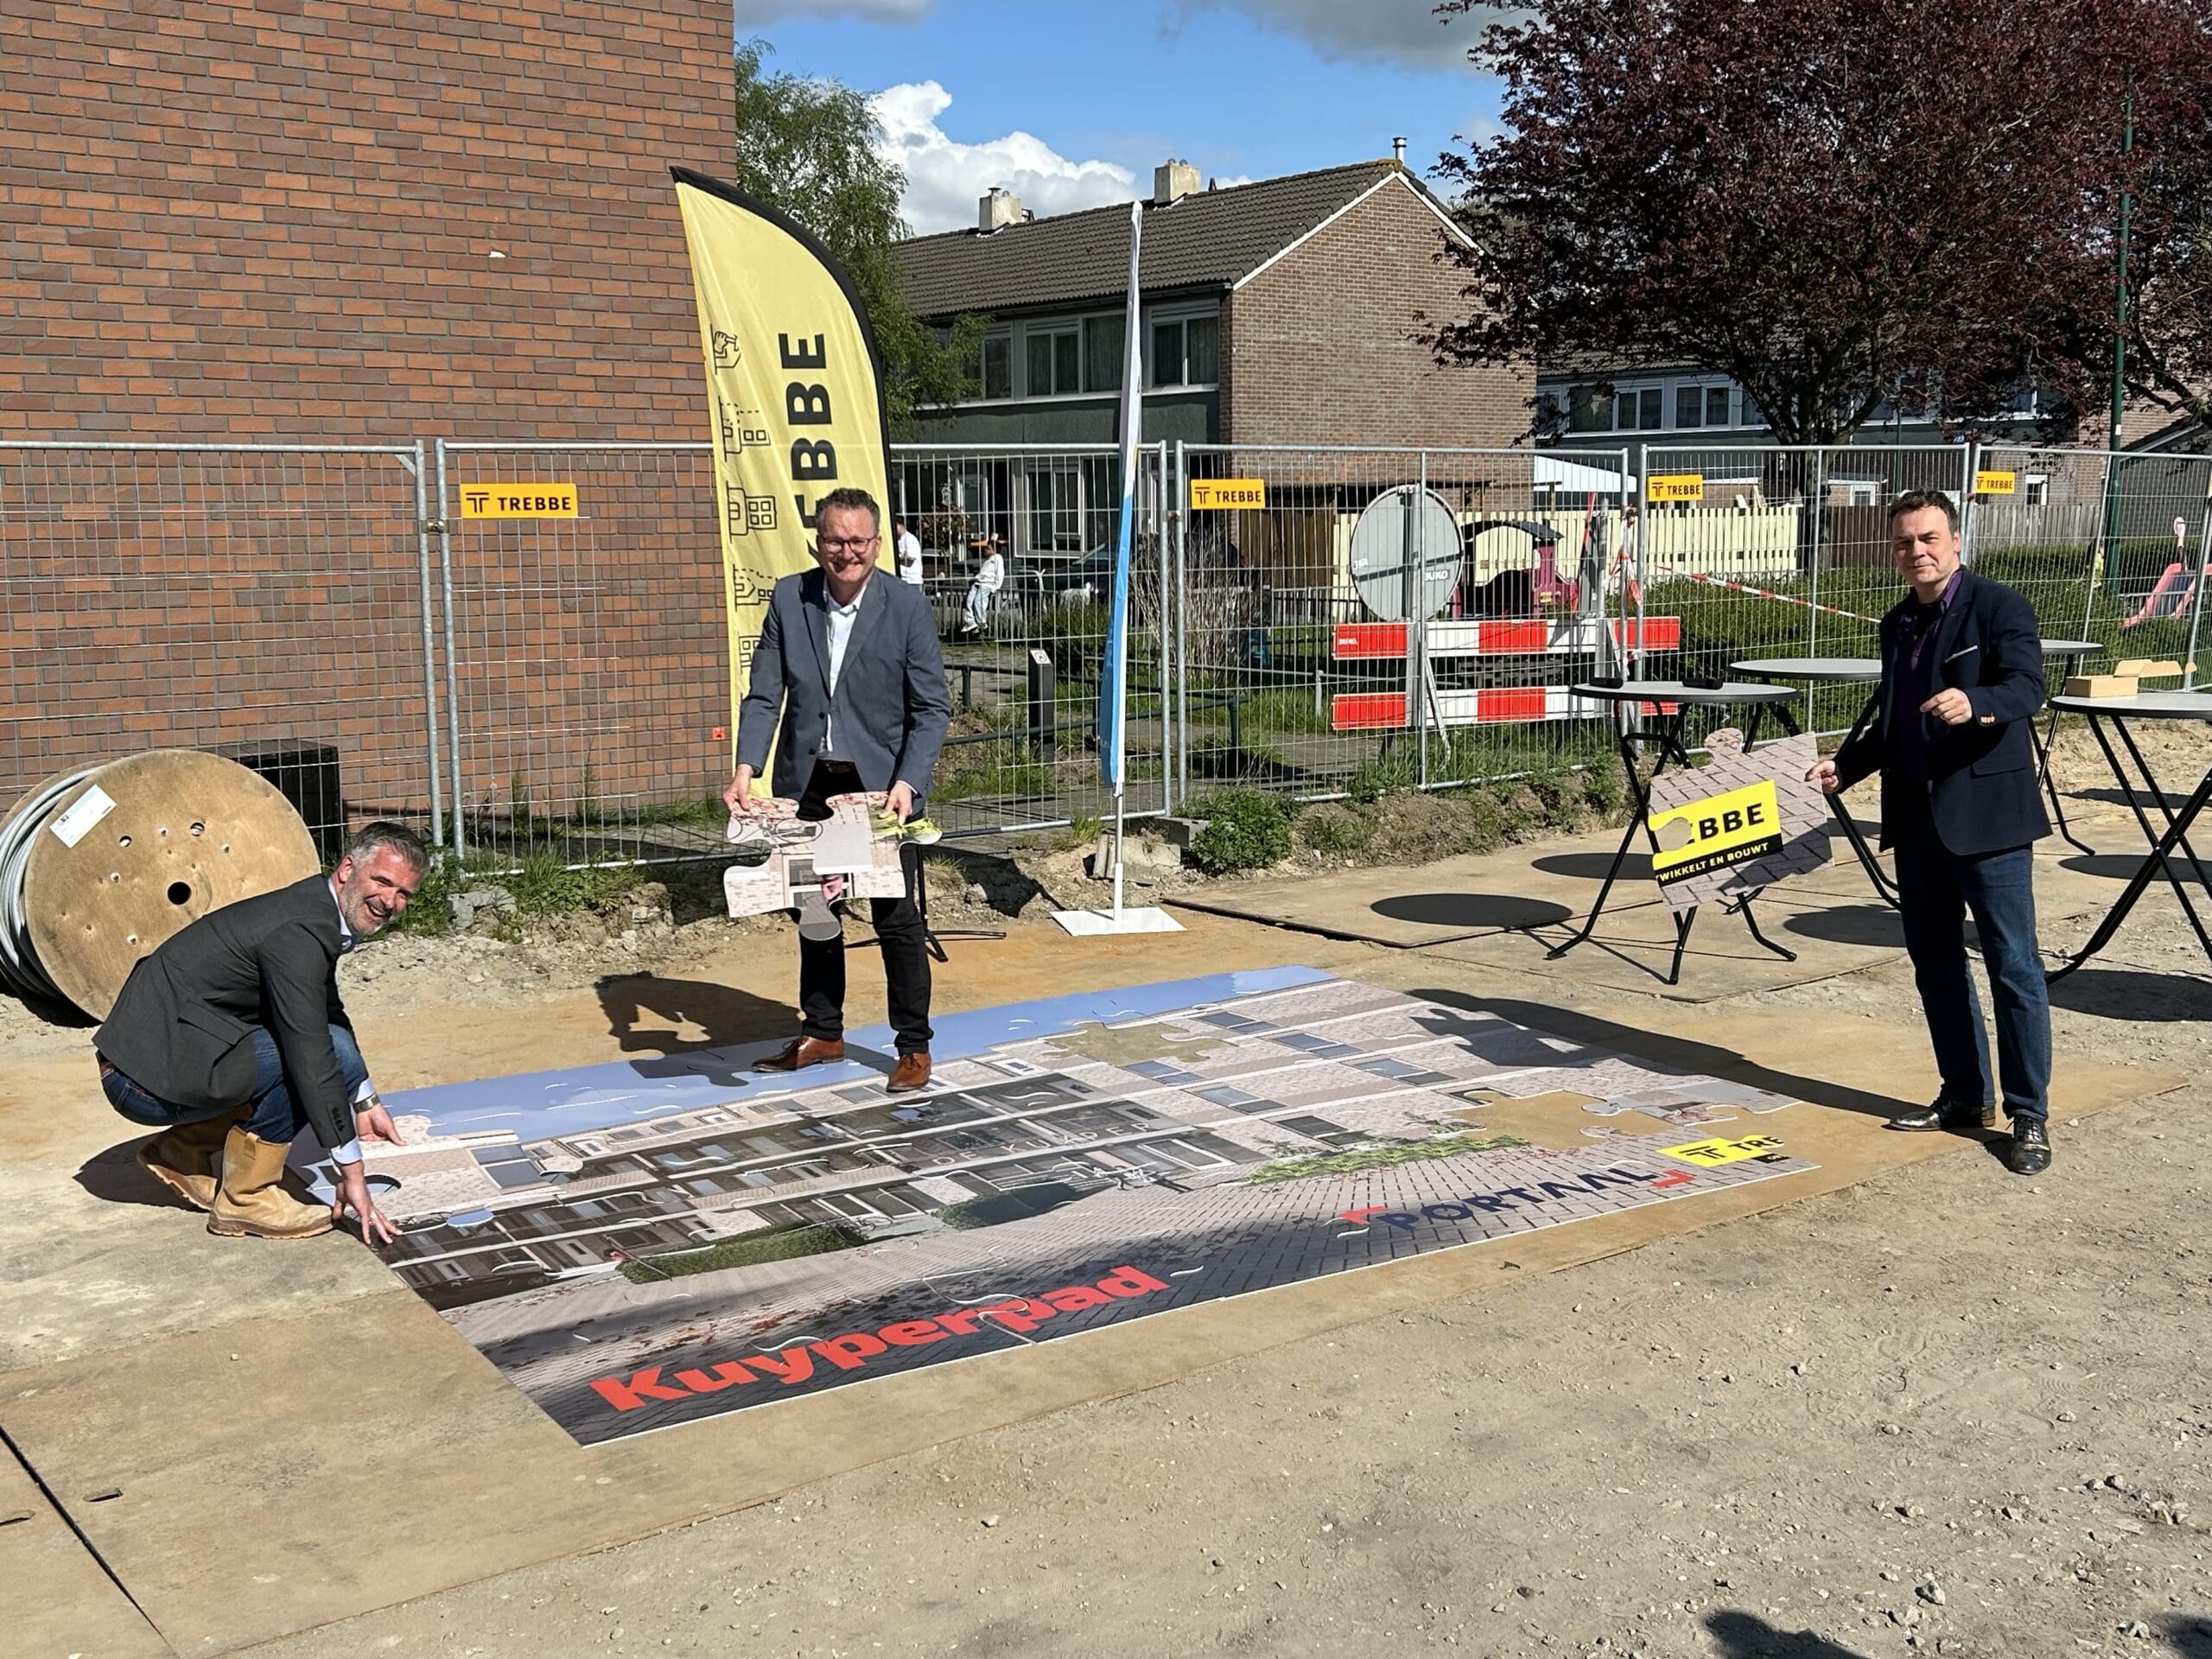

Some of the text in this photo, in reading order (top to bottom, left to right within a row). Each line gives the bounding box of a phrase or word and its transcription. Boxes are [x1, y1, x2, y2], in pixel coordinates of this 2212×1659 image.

[1667, 484, 1700, 496] TREBBE
[1986, 480, 2013, 490] TREBBE
[497, 497, 571, 512] TREBBE
[1215, 490, 1262, 503] TREBBE
[1687, 802, 1765, 846] BBE
[1709, 855, 1725, 867] EN
[1726, 842, 1770, 862] BOUWT
[1376, 1168, 1657, 1231] PORTAAL
[589, 1265, 1171, 1411] Kuyperpad
